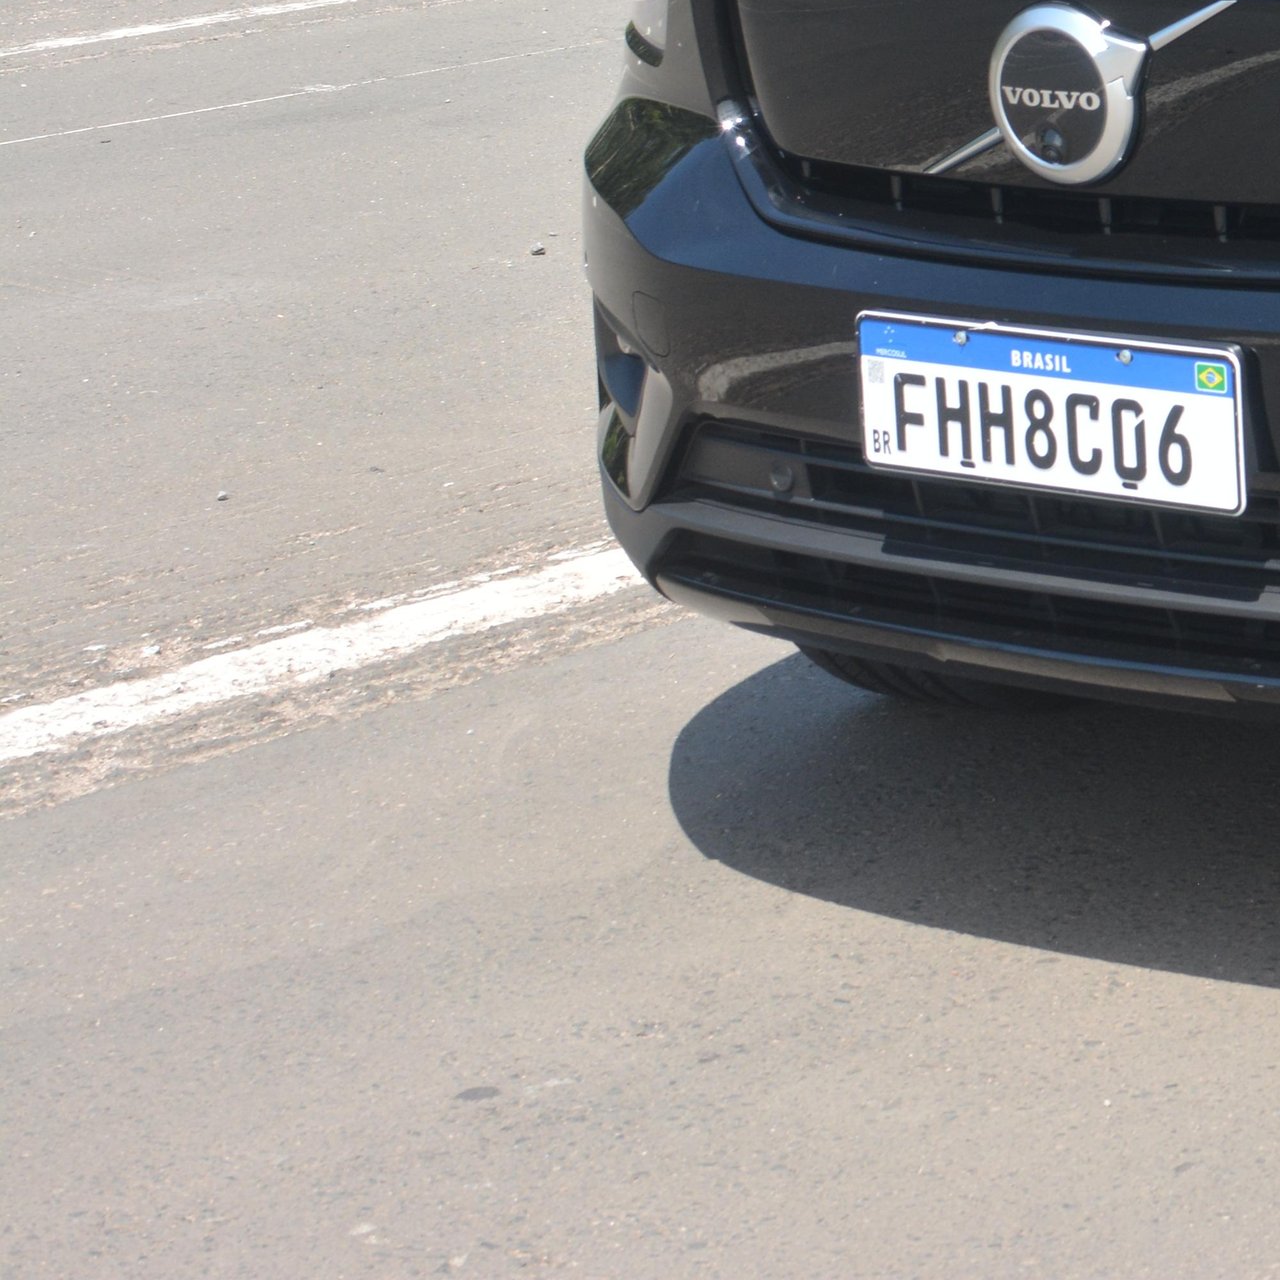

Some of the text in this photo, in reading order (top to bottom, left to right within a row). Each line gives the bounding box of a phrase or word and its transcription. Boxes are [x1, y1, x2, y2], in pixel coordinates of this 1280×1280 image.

[1001, 86, 1101, 111] VOLVO
[1010, 349, 1072, 374] BRASIL
[871, 428, 892, 456] BR
[893, 372, 1193, 487] FHH8C06
